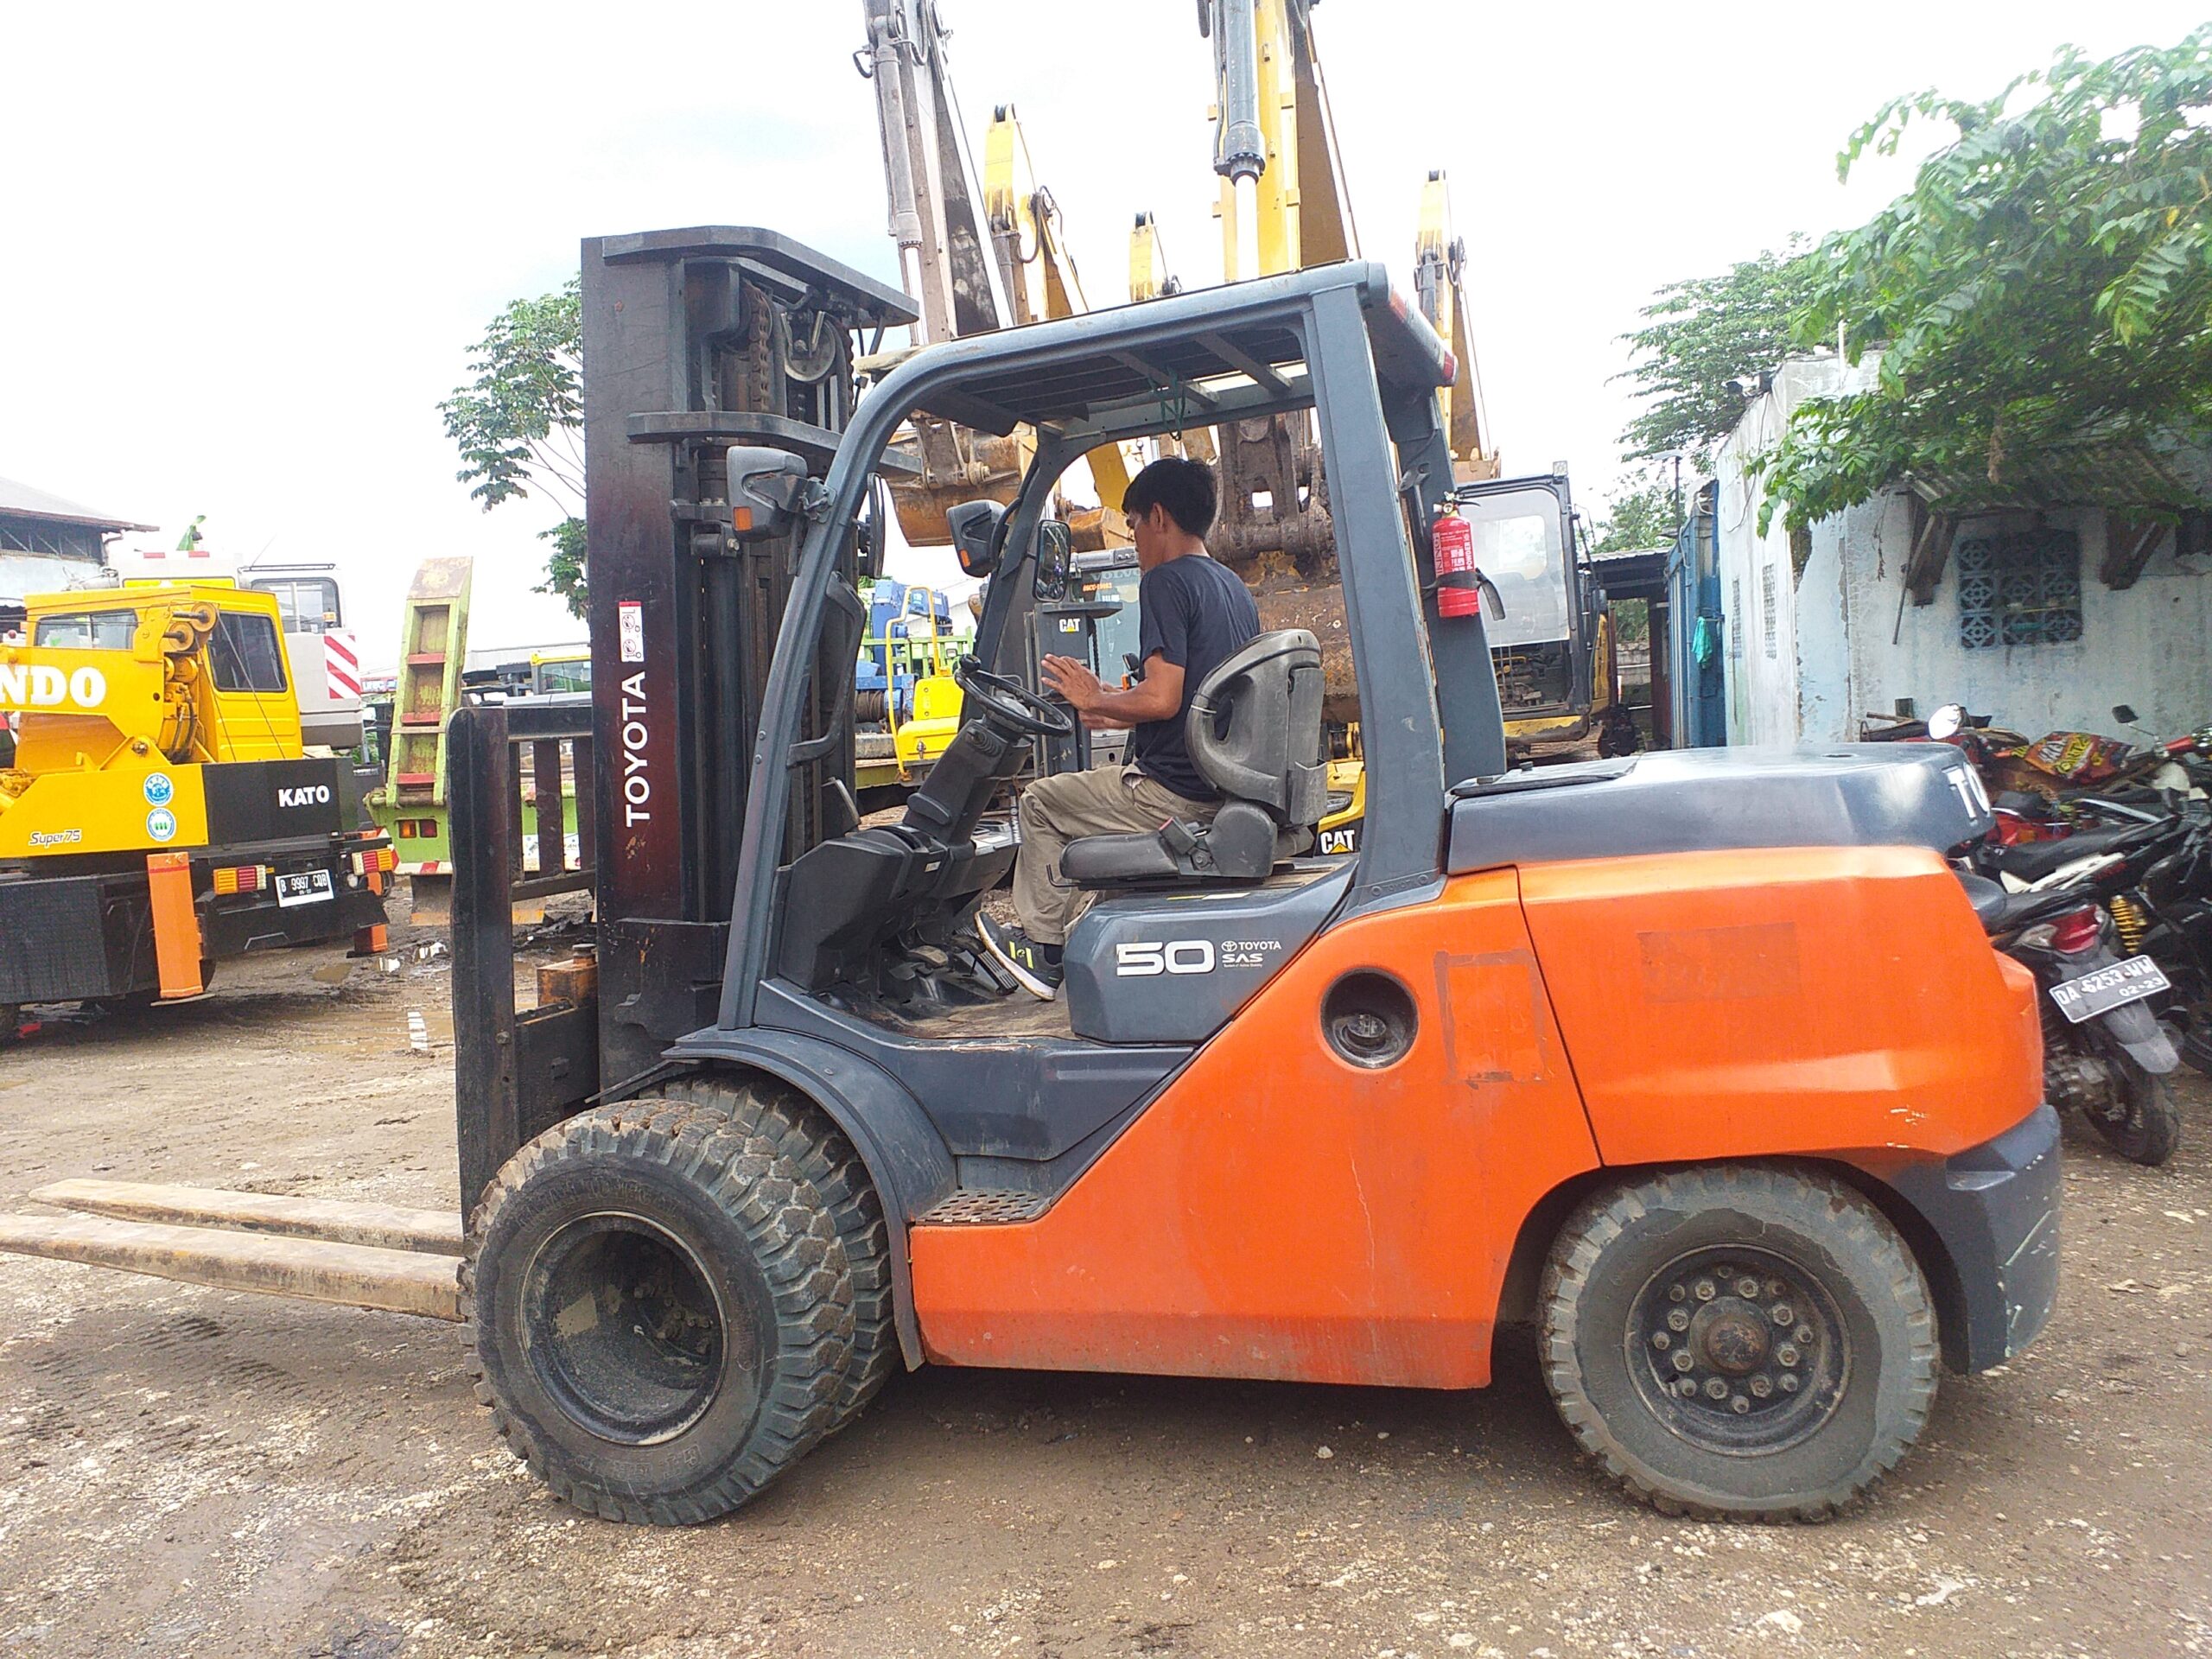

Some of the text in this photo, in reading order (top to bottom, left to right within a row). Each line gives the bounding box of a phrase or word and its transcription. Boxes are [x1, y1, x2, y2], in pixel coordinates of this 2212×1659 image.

[1464, 541, 1473, 570] POWDER
[1058, 618, 1081, 632] CAT
[0, 664, 106, 708] NDO
[621, 671, 650, 827] TOYOTA
[278, 785, 330, 807] KATO
[1320, 830, 1355, 855] CAT
[280, 879, 287, 893] B
[291, 875, 309, 891] 9997
[1116, 939, 1216, 976] 50
[1222, 953, 1263, 963] SAS
[1238, 941, 1281, 950] TOYOTA
[2053, 986, 2082, 1005] DA
[2082, 969, 2126, 993] 6253
